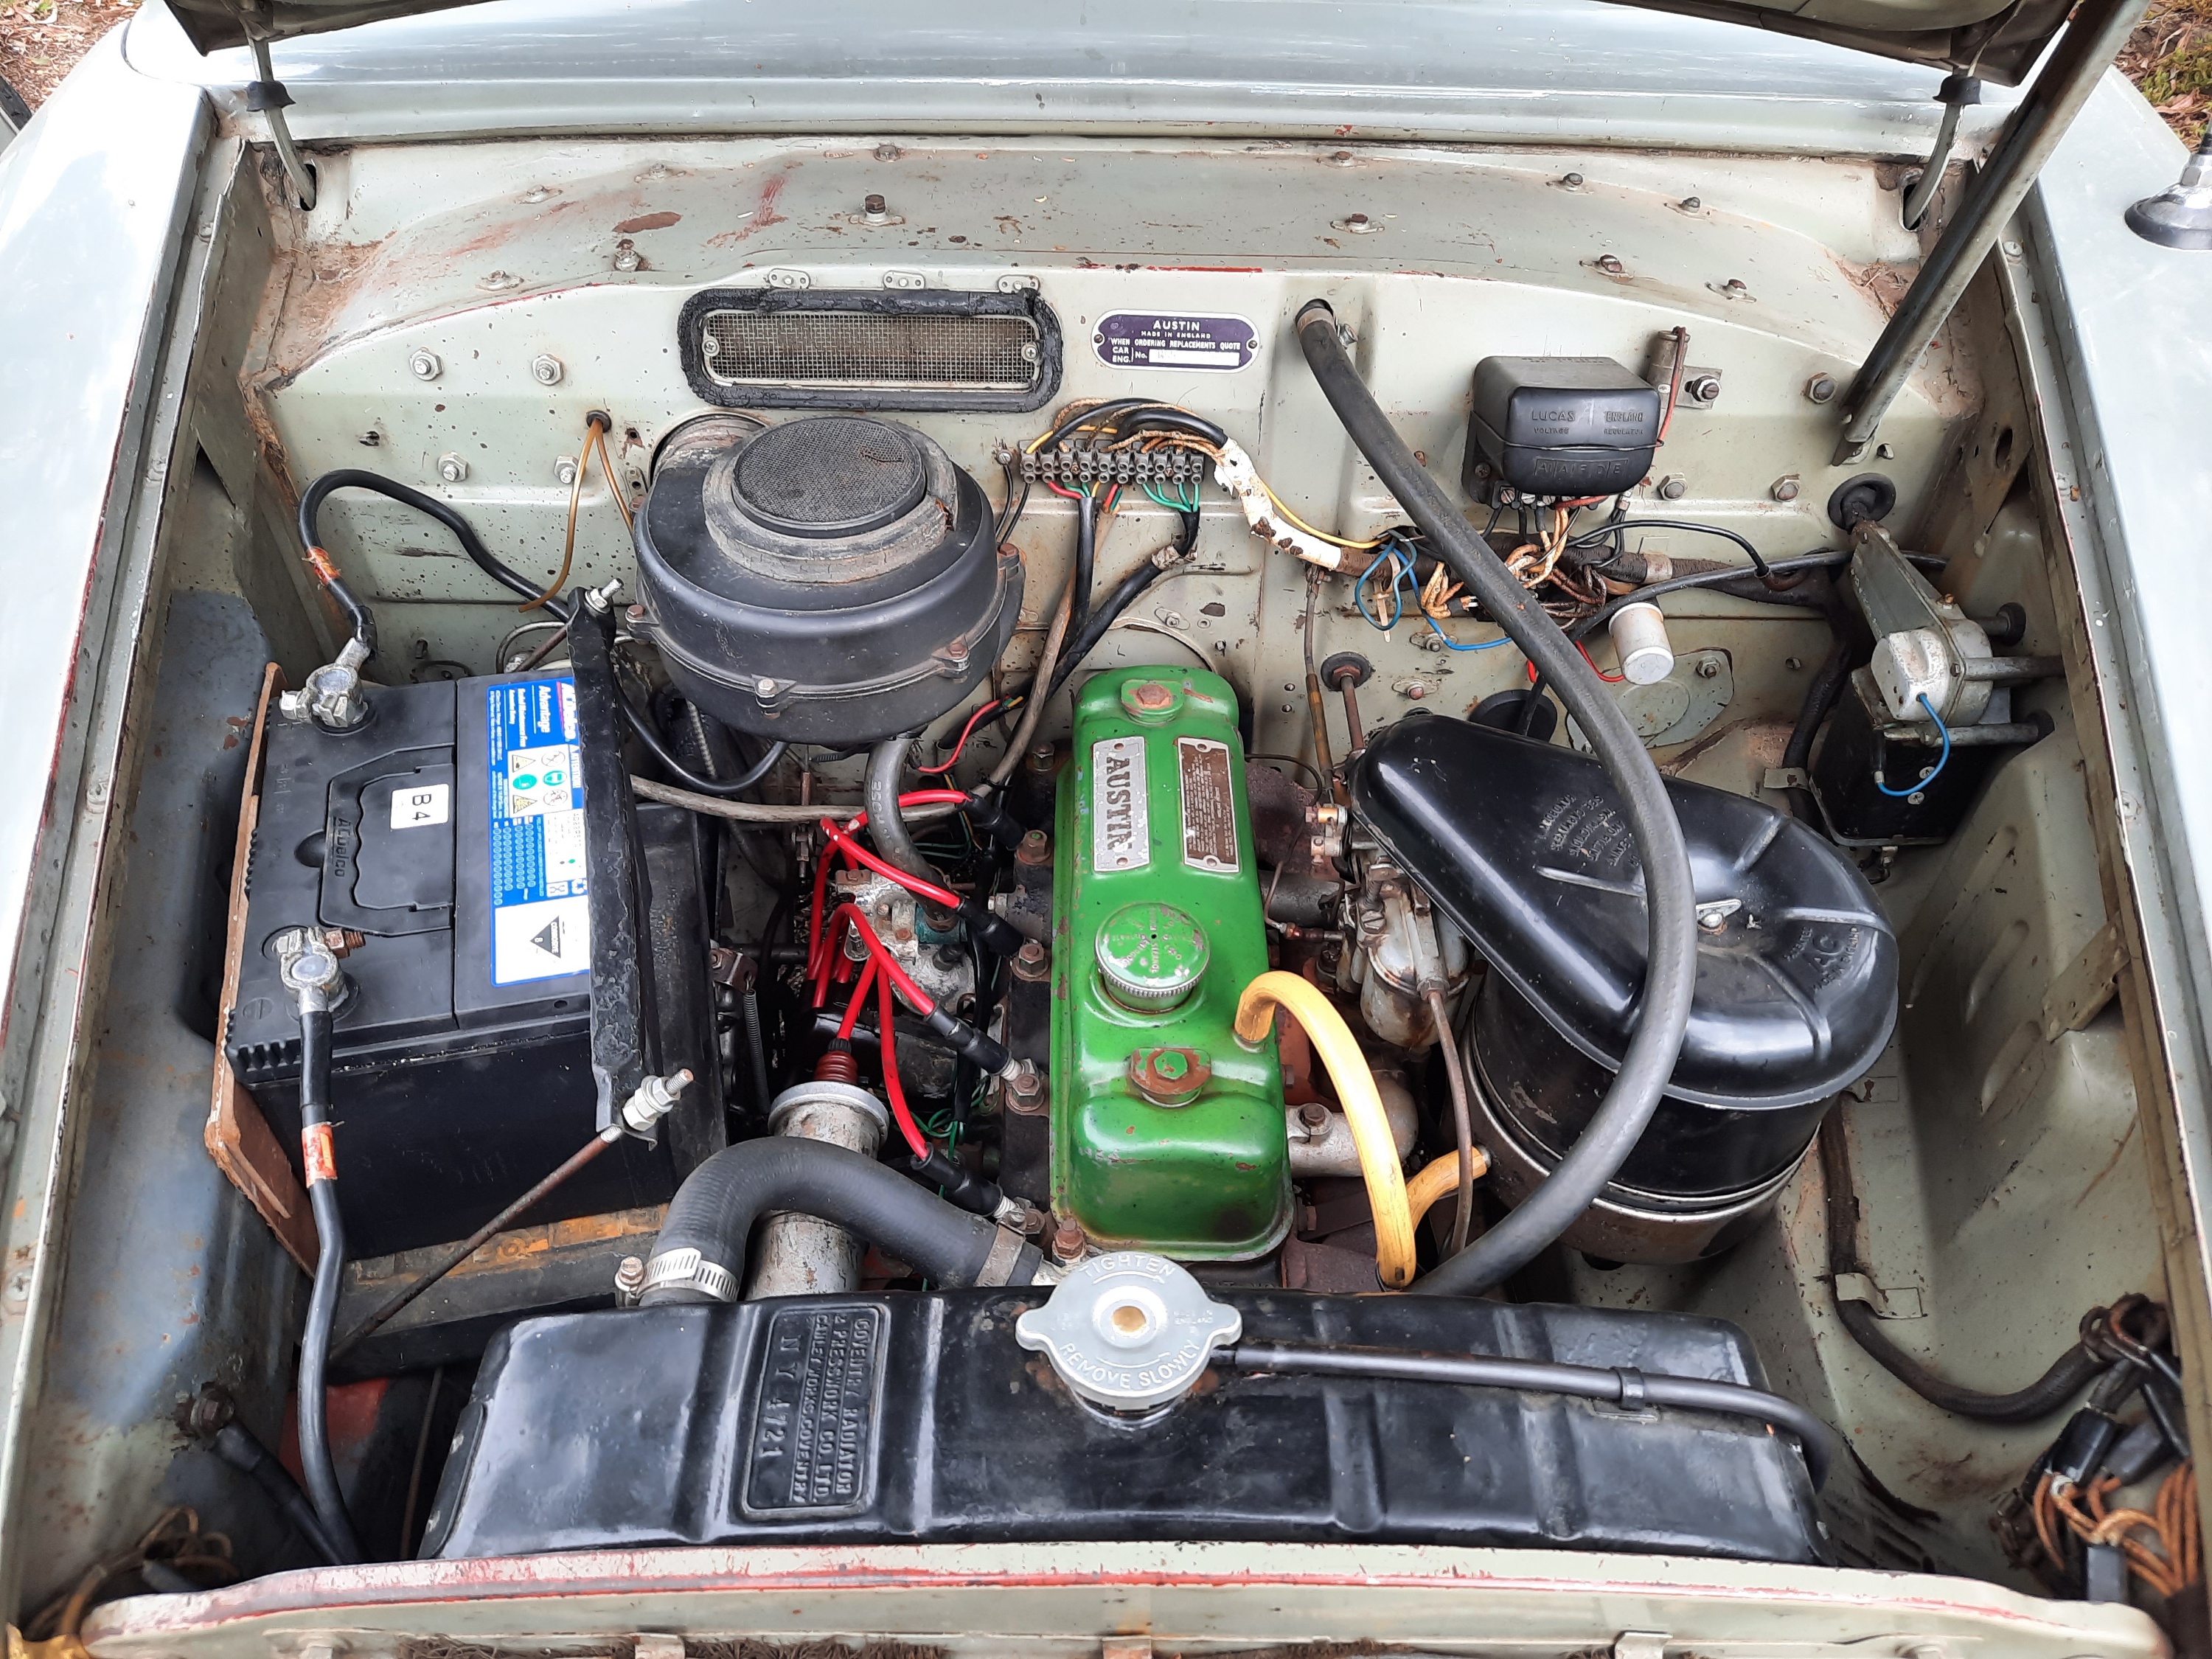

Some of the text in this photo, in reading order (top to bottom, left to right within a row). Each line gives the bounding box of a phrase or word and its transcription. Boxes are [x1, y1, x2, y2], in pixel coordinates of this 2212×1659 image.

[1134, 339, 1166, 347] ORDERING
[1169, 340, 1215, 349] REPLACEMENTS
[1153, 320, 1200, 331] AUSTIN
[1532, 411, 1644, 422] LUCAS ENGLAND
[538, 685, 551, 733] Advantage
[412, 793, 432, 821] B 4
[871, 780, 885, 824] HOSE
[1107, 757, 1132, 850] AUSTIN
[1540, 793, 1578, 832] HANDBOOK
[1582, 794, 1604, 811] SEE
[335, 817, 352, 877] ACDelco
[1569, 807, 1616, 857] INSTRUCTIONS
[1609, 820, 1626, 837] AND
[1079, 1254, 1176, 1278] TIGHTEN
[810, 1314, 829, 1364] CANLEY
[821, 1330, 848, 1420] PRESSWORK
[1059, 1339, 1201, 1389] REMOVE SLOWLY
[759, 1334, 801, 1457] N Y 4721
[836, 1318, 871, 1494] COVENTRY RADIATOR
[793, 1419, 814, 1503] COVENTRY
[817, 1430, 835, 1460] CO.
[812, 1464, 833, 1503] LTD.
